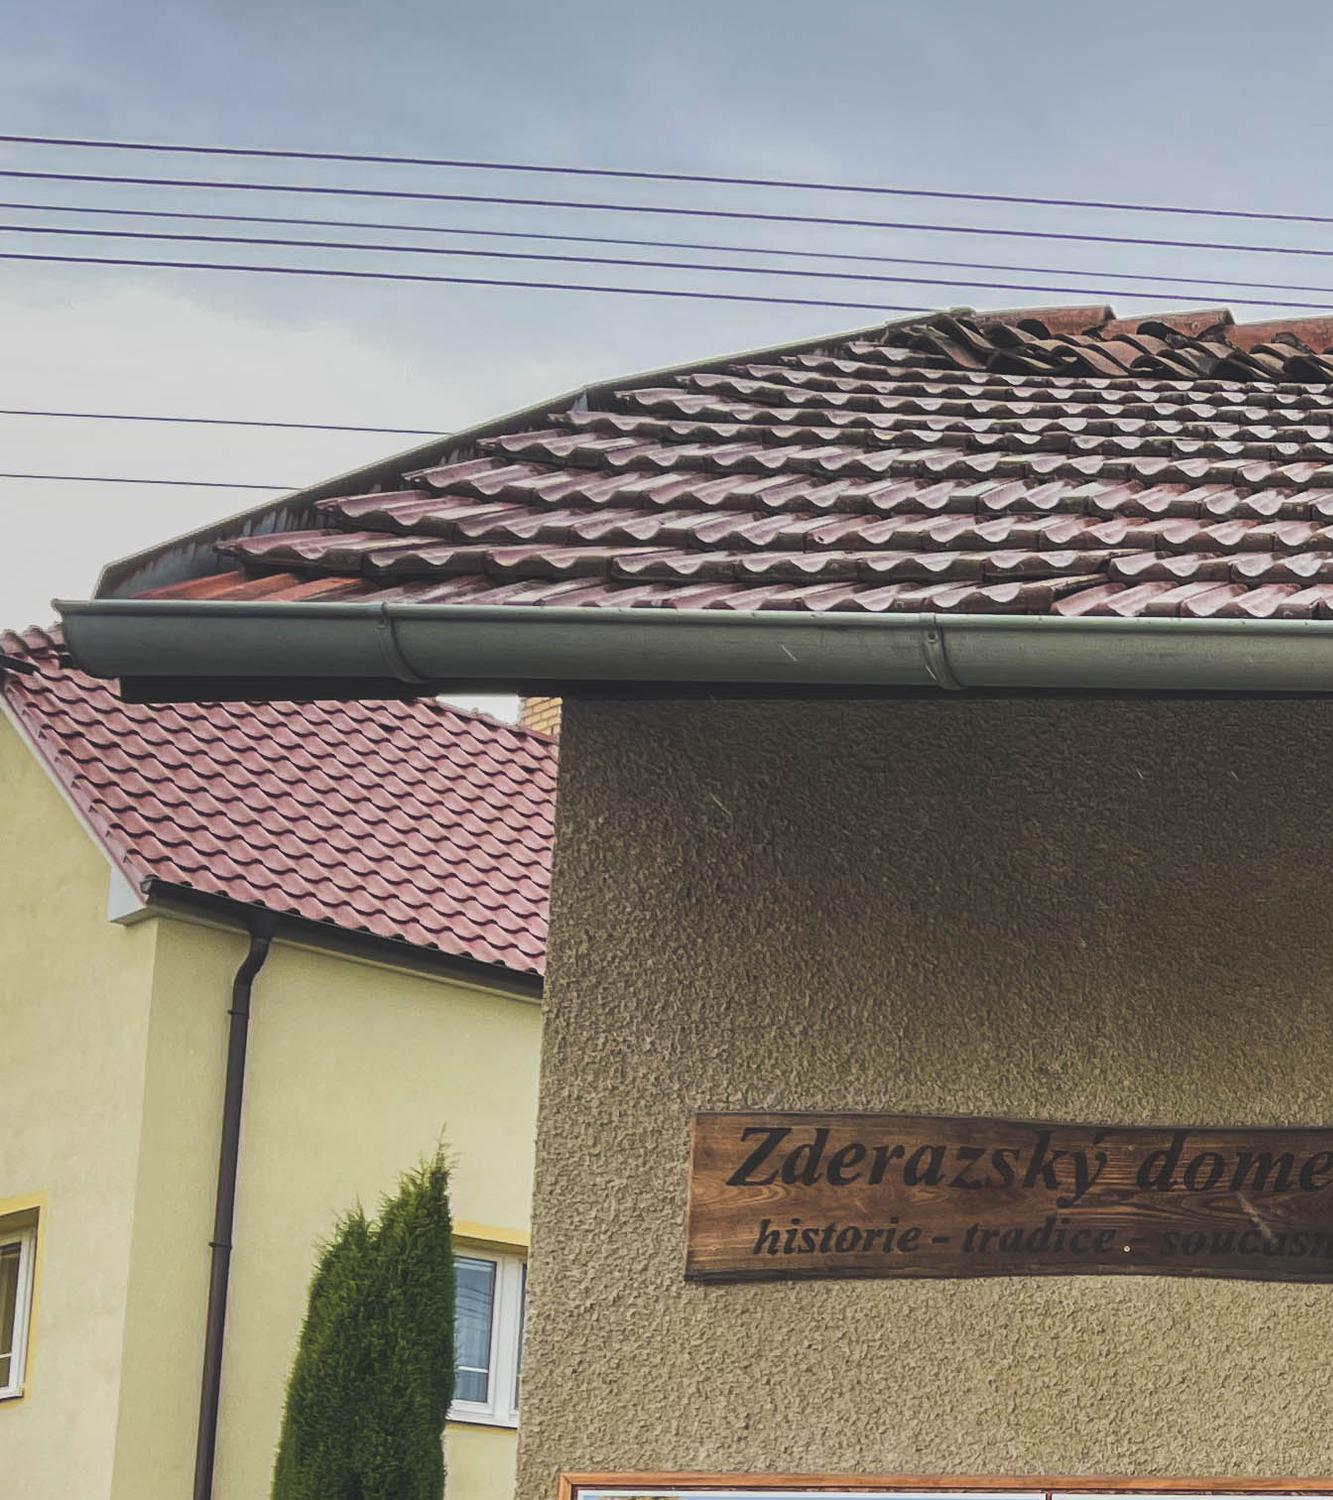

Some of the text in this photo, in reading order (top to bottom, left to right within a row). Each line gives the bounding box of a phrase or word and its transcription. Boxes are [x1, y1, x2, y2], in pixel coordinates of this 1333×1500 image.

[725, 1125, 1108, 1208] Zderazský
[752, 1216, 922, 1256] historie
[961, 1213, 1117, 1257] tradice
